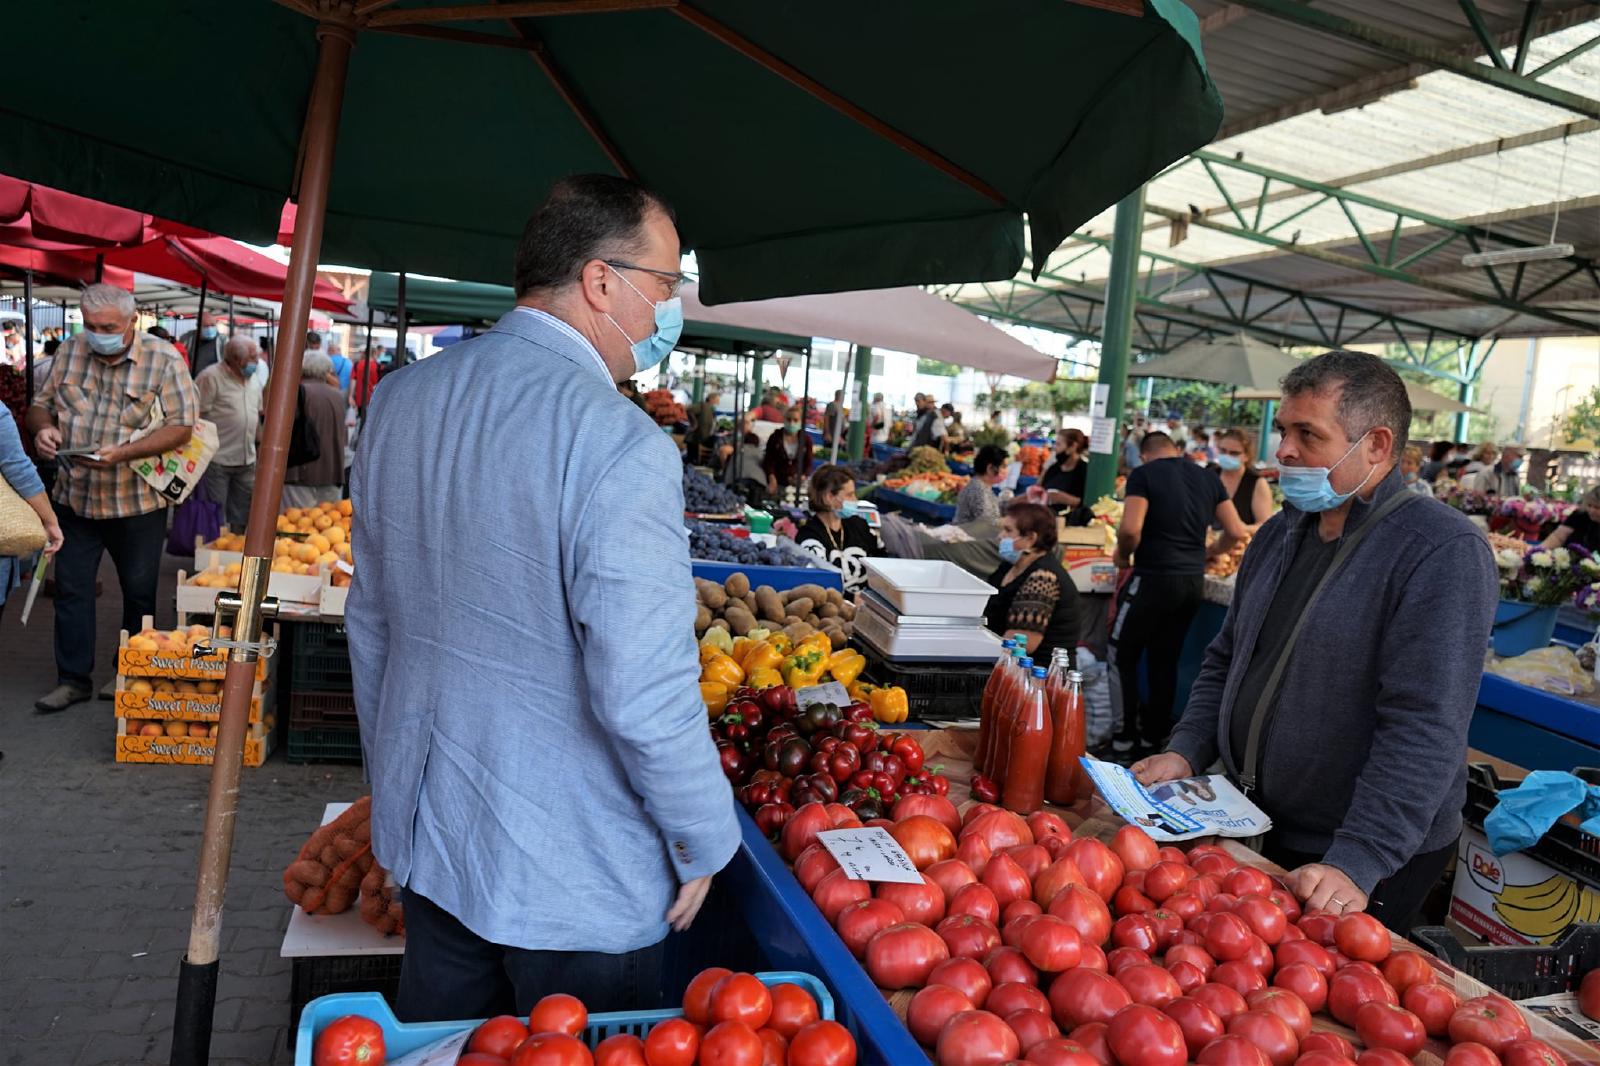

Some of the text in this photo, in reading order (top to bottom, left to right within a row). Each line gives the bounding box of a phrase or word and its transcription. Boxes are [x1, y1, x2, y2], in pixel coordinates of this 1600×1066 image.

[150, 656, 187, 670] Sweet
[148, 698, 182, 713] Sweet
[149, 742, 184, 756] Sweet
[1472, 853, 1501, 880] Dole
